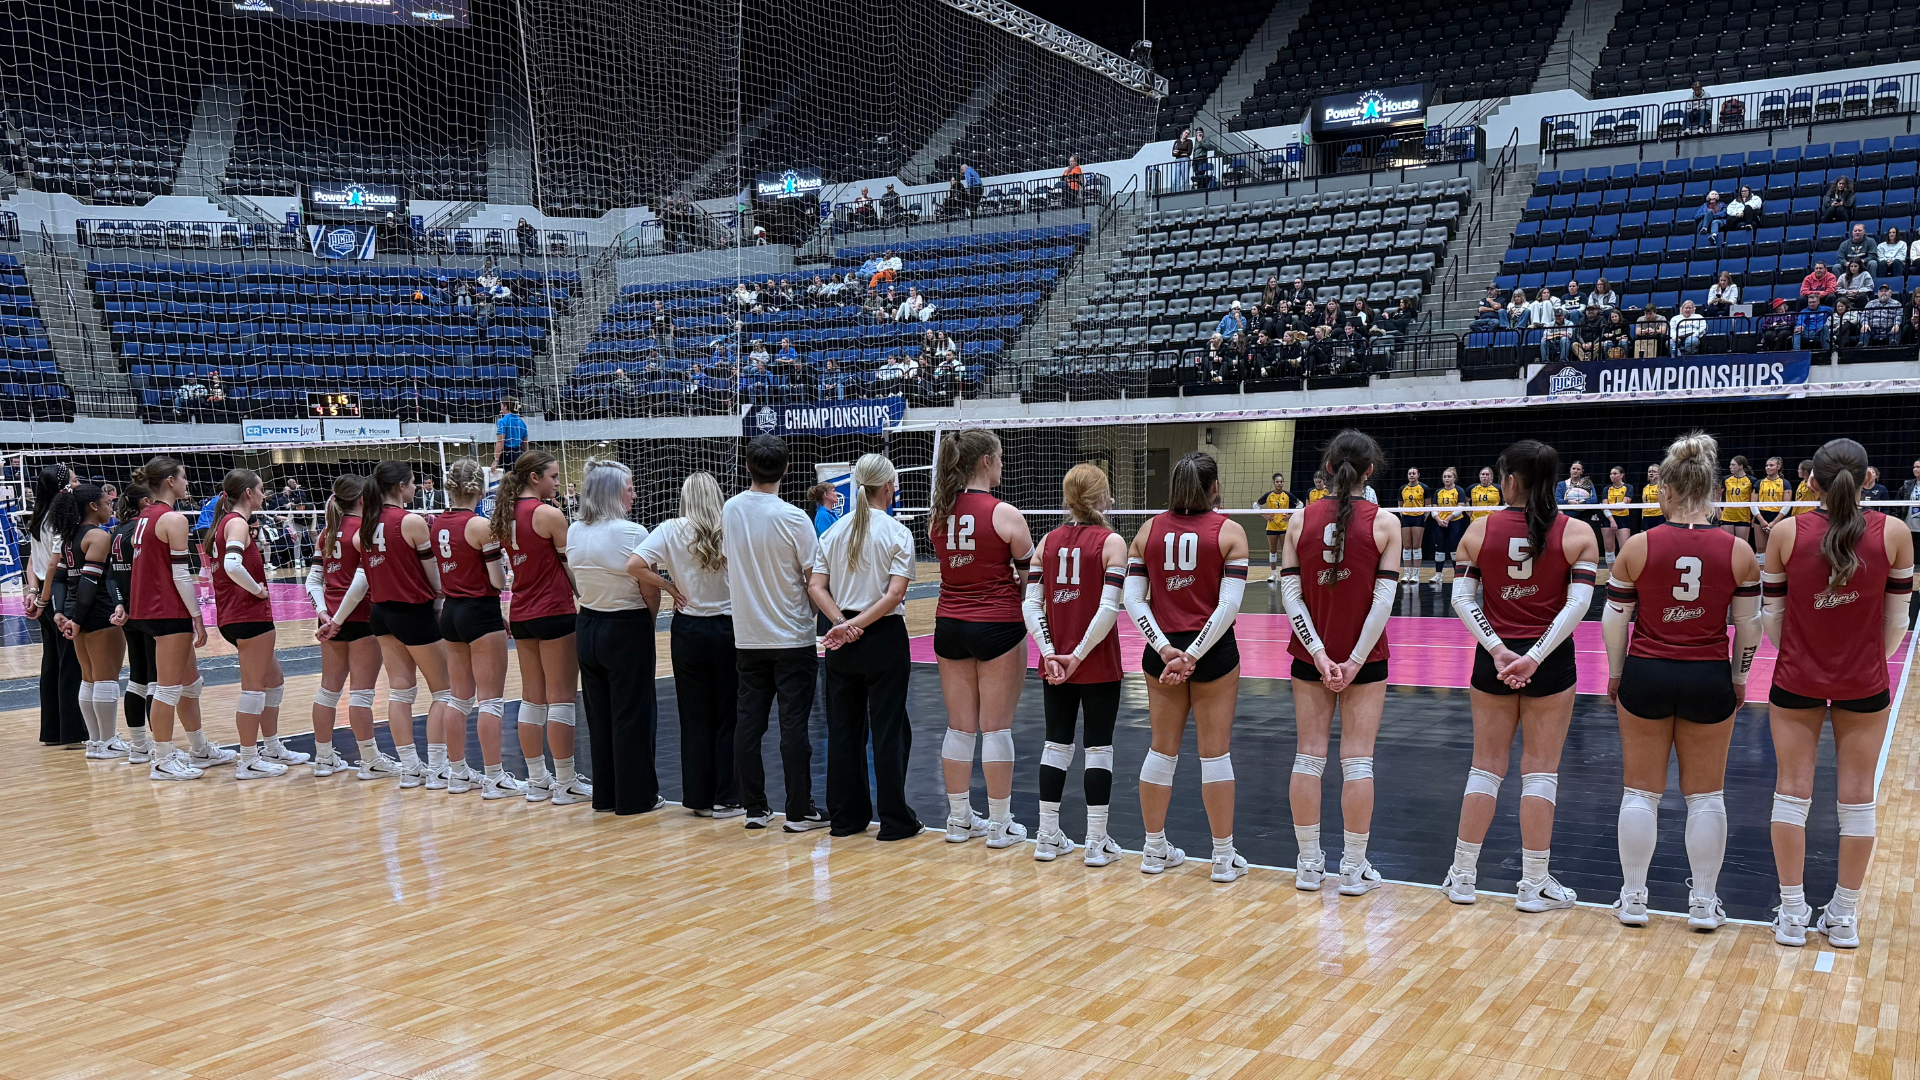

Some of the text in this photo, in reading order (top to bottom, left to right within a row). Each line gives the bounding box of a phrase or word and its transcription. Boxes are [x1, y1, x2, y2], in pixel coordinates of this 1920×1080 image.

[1325, 99, 1419, 120] Power House
[314, 191, 397, 203] Power House
[758, 178, 822, 194] Power House
[1551, 375, 1584, 393] NJCAA
[1599, 362, 1785, 394] CHAMPIONSHIPS
[330, 406, 338, 416] 5
[784, 405, 890, 430] CHAMPIONSHIPS
[262, 427, 299, 435] EVENTS
[133, 517, 150, 545] 17
[438, 528, 452, 559] 8
[946, 514, 976, 551] 12
[1322, 522, 1346, 564] 9
[64, 540, 75, 568] 6
[111, 533, 124, 562] 4
[1163, 532, 1199, 571] 10
[1507, 537, 1533, 580] 5
[1056, 547, 1081, 585] 11
[1671, 555, 1703, 602] 3
[1053, 588, 1080, 604] Flyers
[1166, 574, 1196, 592] Flyers
[1501, 584, 1540, 600] Flyers
[1662, 605, 1706, 623] Flyers
[1814, 590, 1860, 610] Flyers
[1038, 615, 1051, 646] FLYERS
[1137, 614, 1158, 644] FLYERS
[1292, 613, 1314, 646] FLYERS
[1470, 607, 1495, 638] FLYERS
